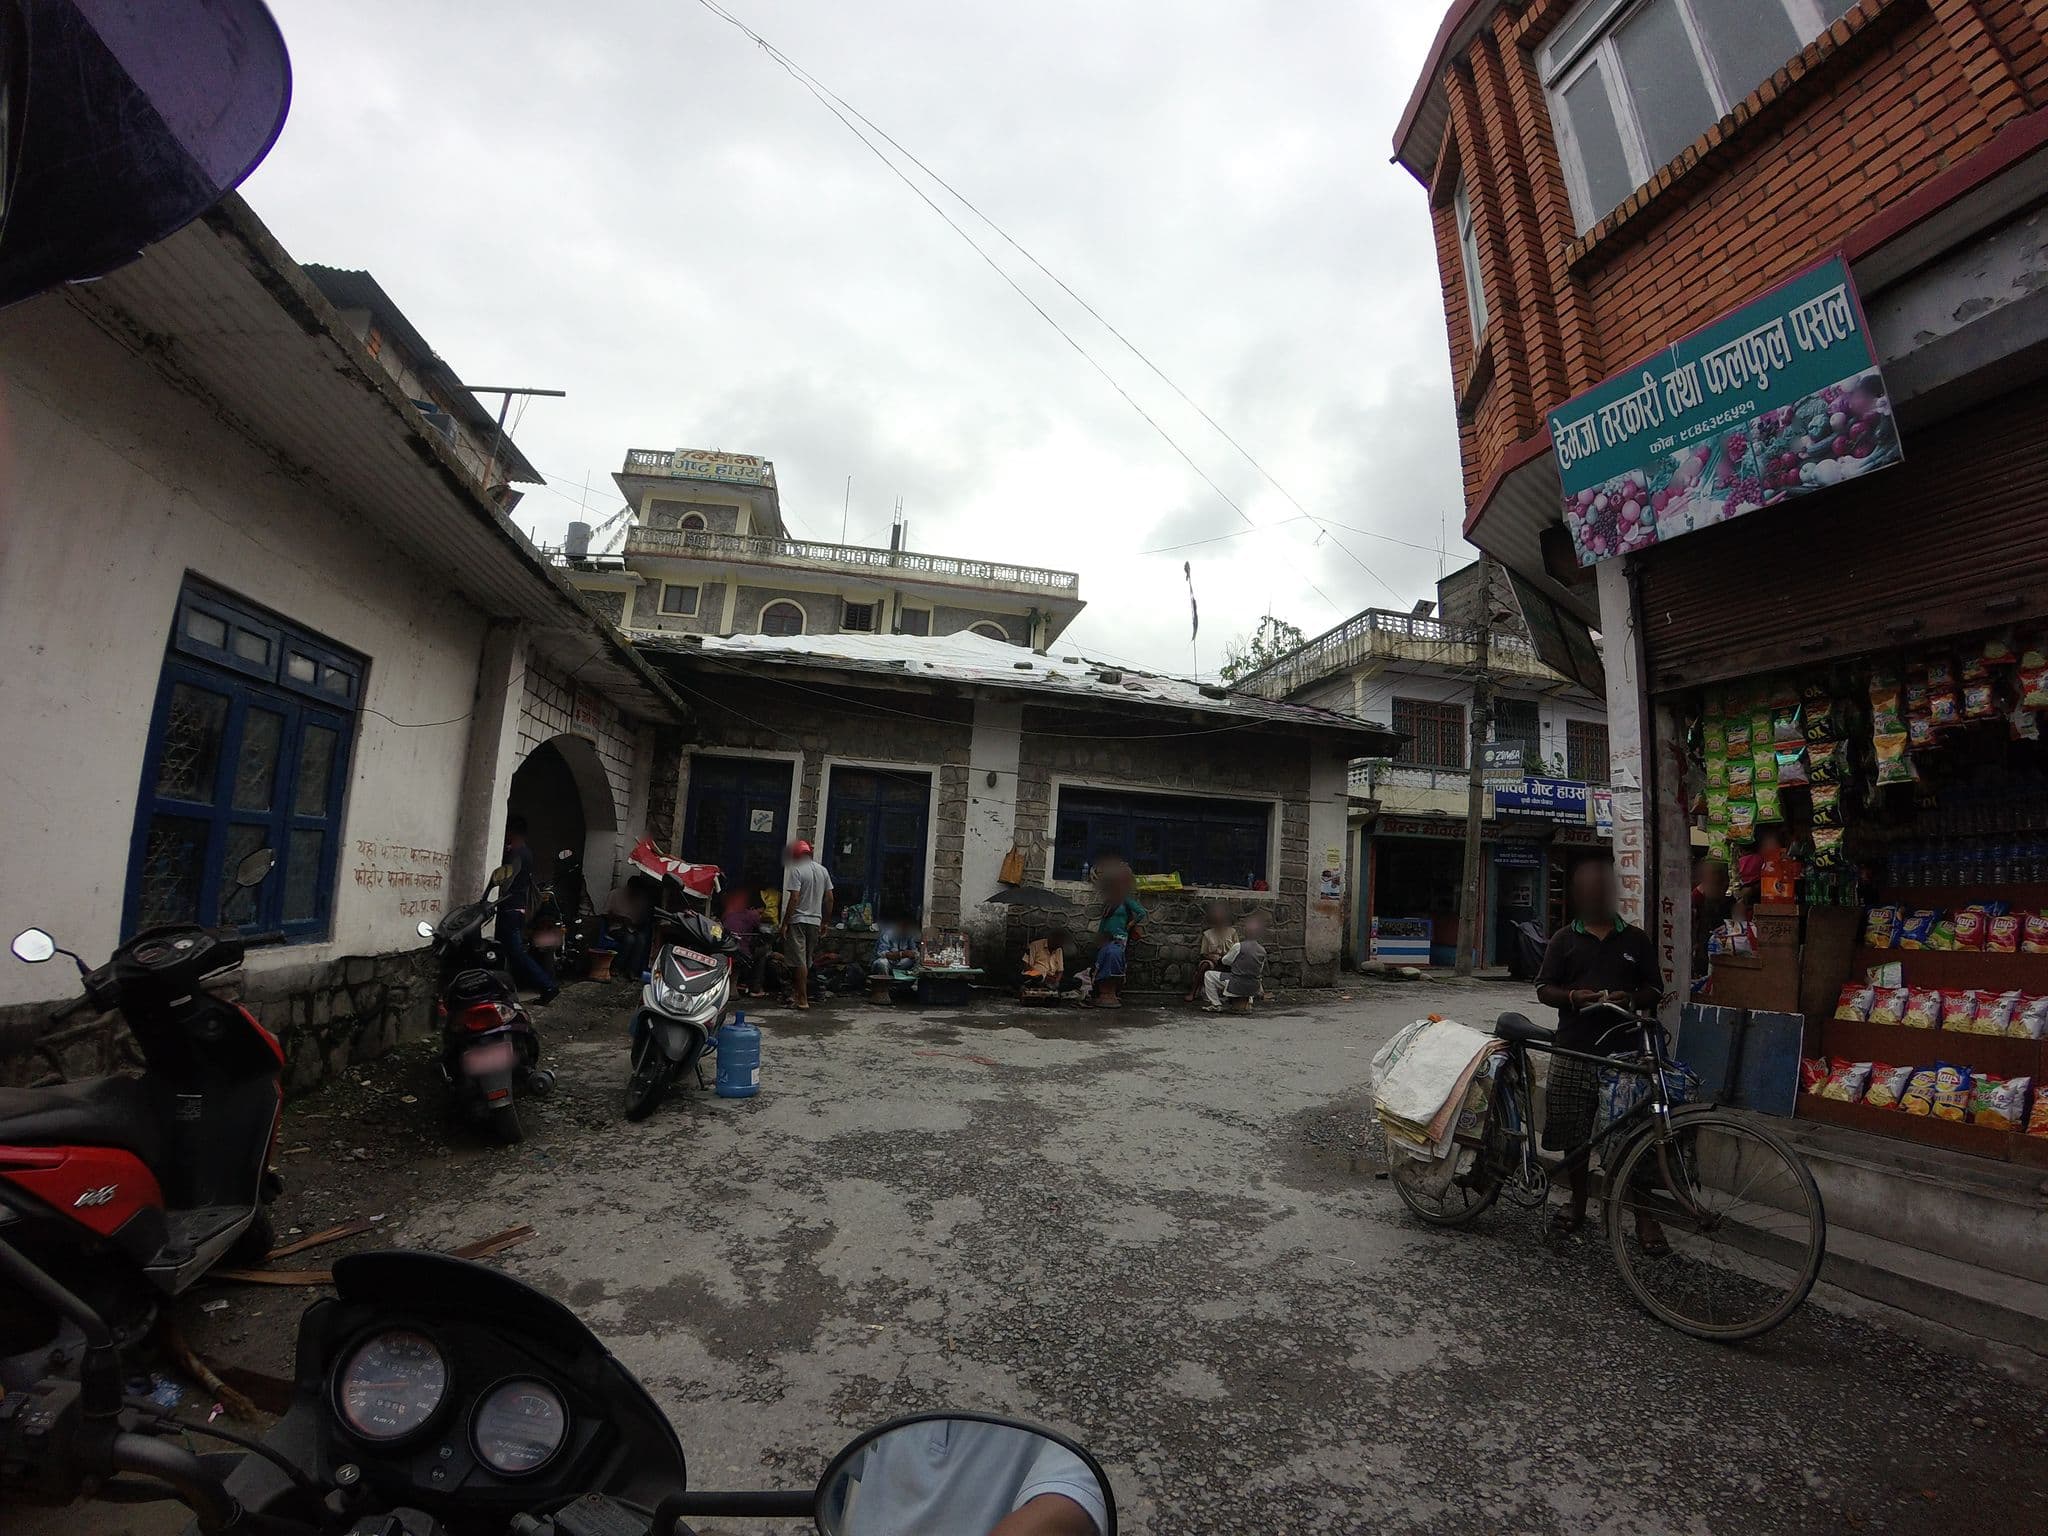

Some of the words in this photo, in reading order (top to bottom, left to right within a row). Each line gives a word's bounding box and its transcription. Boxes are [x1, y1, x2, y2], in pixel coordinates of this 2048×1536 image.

[1553, 412, 1600, 470] हेमजा
[1598, 371, 1664, 449] तरकारी
[1661, 361, 1704, 419] तथा
[1700, 316, 1792, 395] फलफुल
[1788, 283, 1857, 354] पसल
[1495, 749, 1521, 761] ZUMBA
[1556, 786, 1587, 802] हाउस
[373, 1414, 397, 1425] km/h
